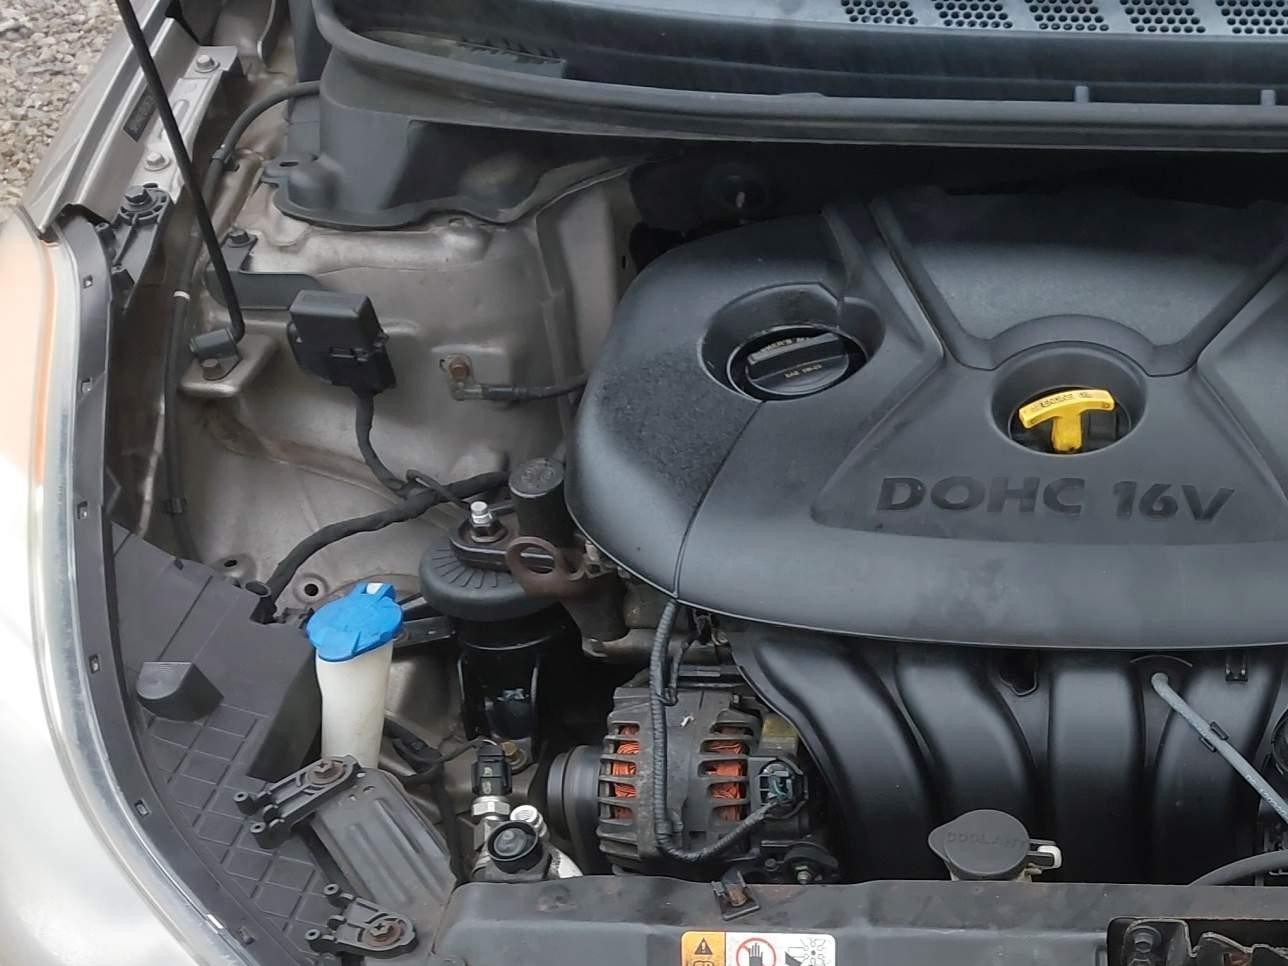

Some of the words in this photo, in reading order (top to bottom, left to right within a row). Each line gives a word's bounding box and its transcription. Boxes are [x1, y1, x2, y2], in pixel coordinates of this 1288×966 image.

[876, 476, 1086, 514] DOHC
[1112, 480, 1236, 522] 16V
[946, 830, 1025, 849] COOLANT
